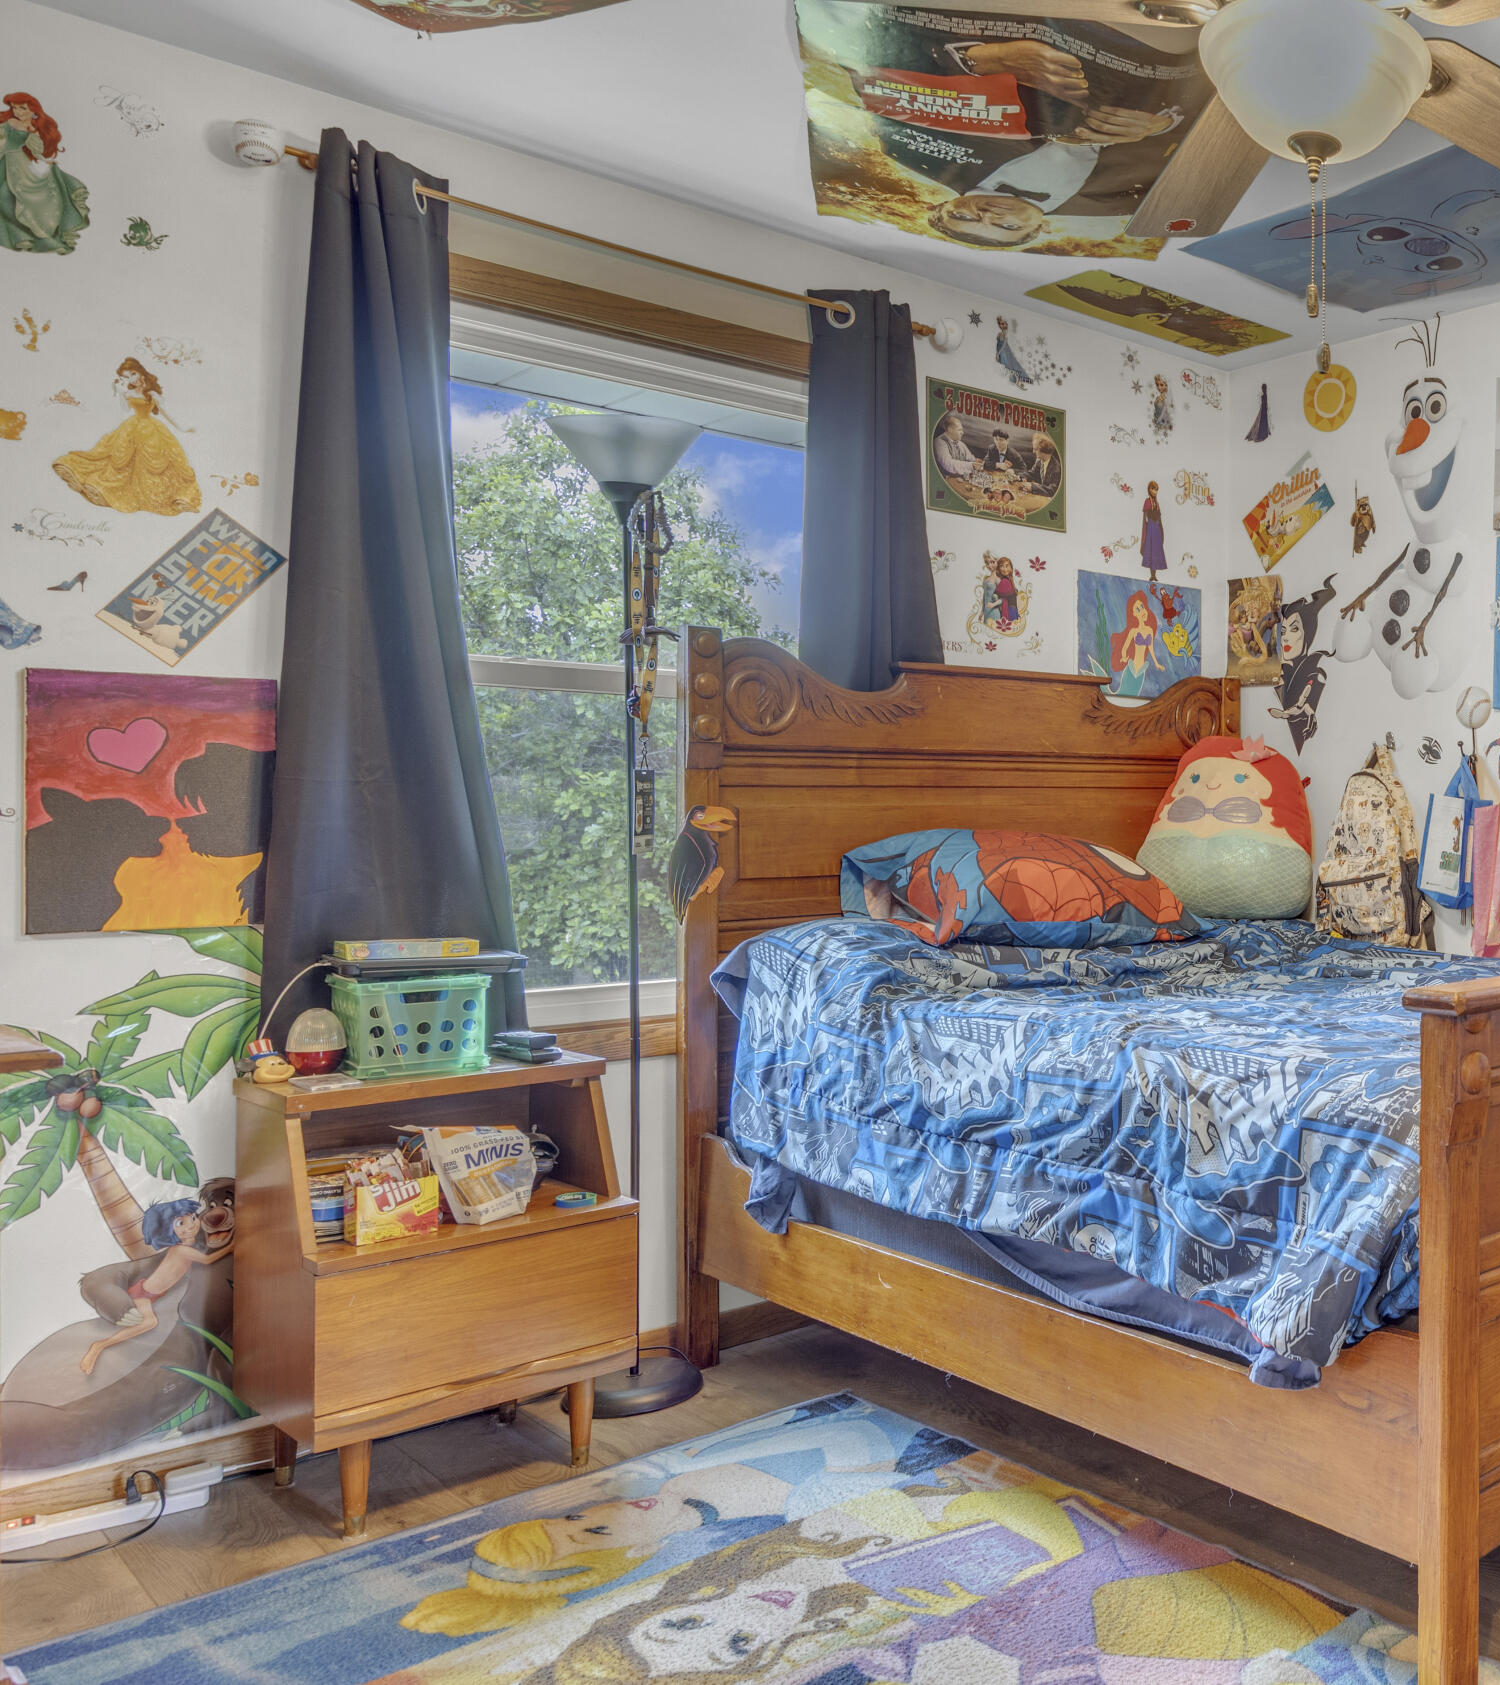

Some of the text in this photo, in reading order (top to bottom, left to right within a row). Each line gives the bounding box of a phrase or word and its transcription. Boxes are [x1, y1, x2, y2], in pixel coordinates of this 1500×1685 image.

[863, 84, 987, 109] ENGLISH
[875, 80, 958, 98] REBORN
[886, 104, 1009, 127] ROWAN ATKINSON
[896, 100, 1020, 121] JOHNNY
[944, 387, 1048, 433] 3 JOKER POKER
[1268, 466, 1321, 505] Chillin
[207, 514, 278, 570] WILD
[179, 531, 263, 595] FOR
[154, 551, 239, 615] SUM
[450, 1136, 512, 1156] 100% GRASS-FED
[462, 1142, 525, 1170] MINIS
[382, 1179, 421, 1213] jim
